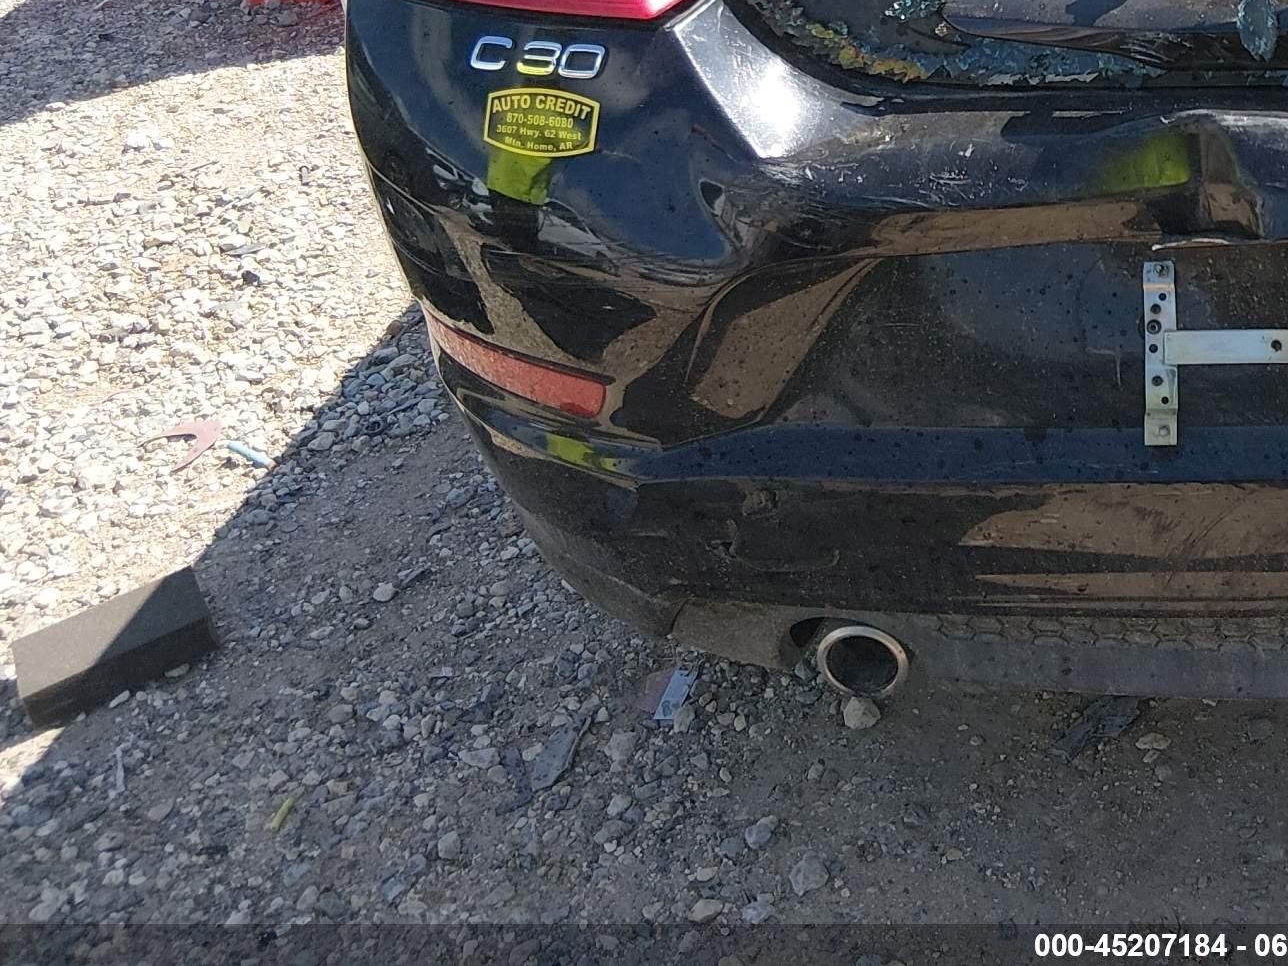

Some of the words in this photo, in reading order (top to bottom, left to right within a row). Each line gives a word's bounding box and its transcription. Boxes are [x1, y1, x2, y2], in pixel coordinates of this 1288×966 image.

[470, 35, 607, 79] C30
[492, 95, 531, 114] AUTO
[535, 95, 592, 120] CREDIT
[506, 112, 574, 129] 870-508-6080
[558, 131, 582, 141] West
[526, 141, 558, 153] Home,
[559, 142, 574, 151] AR
